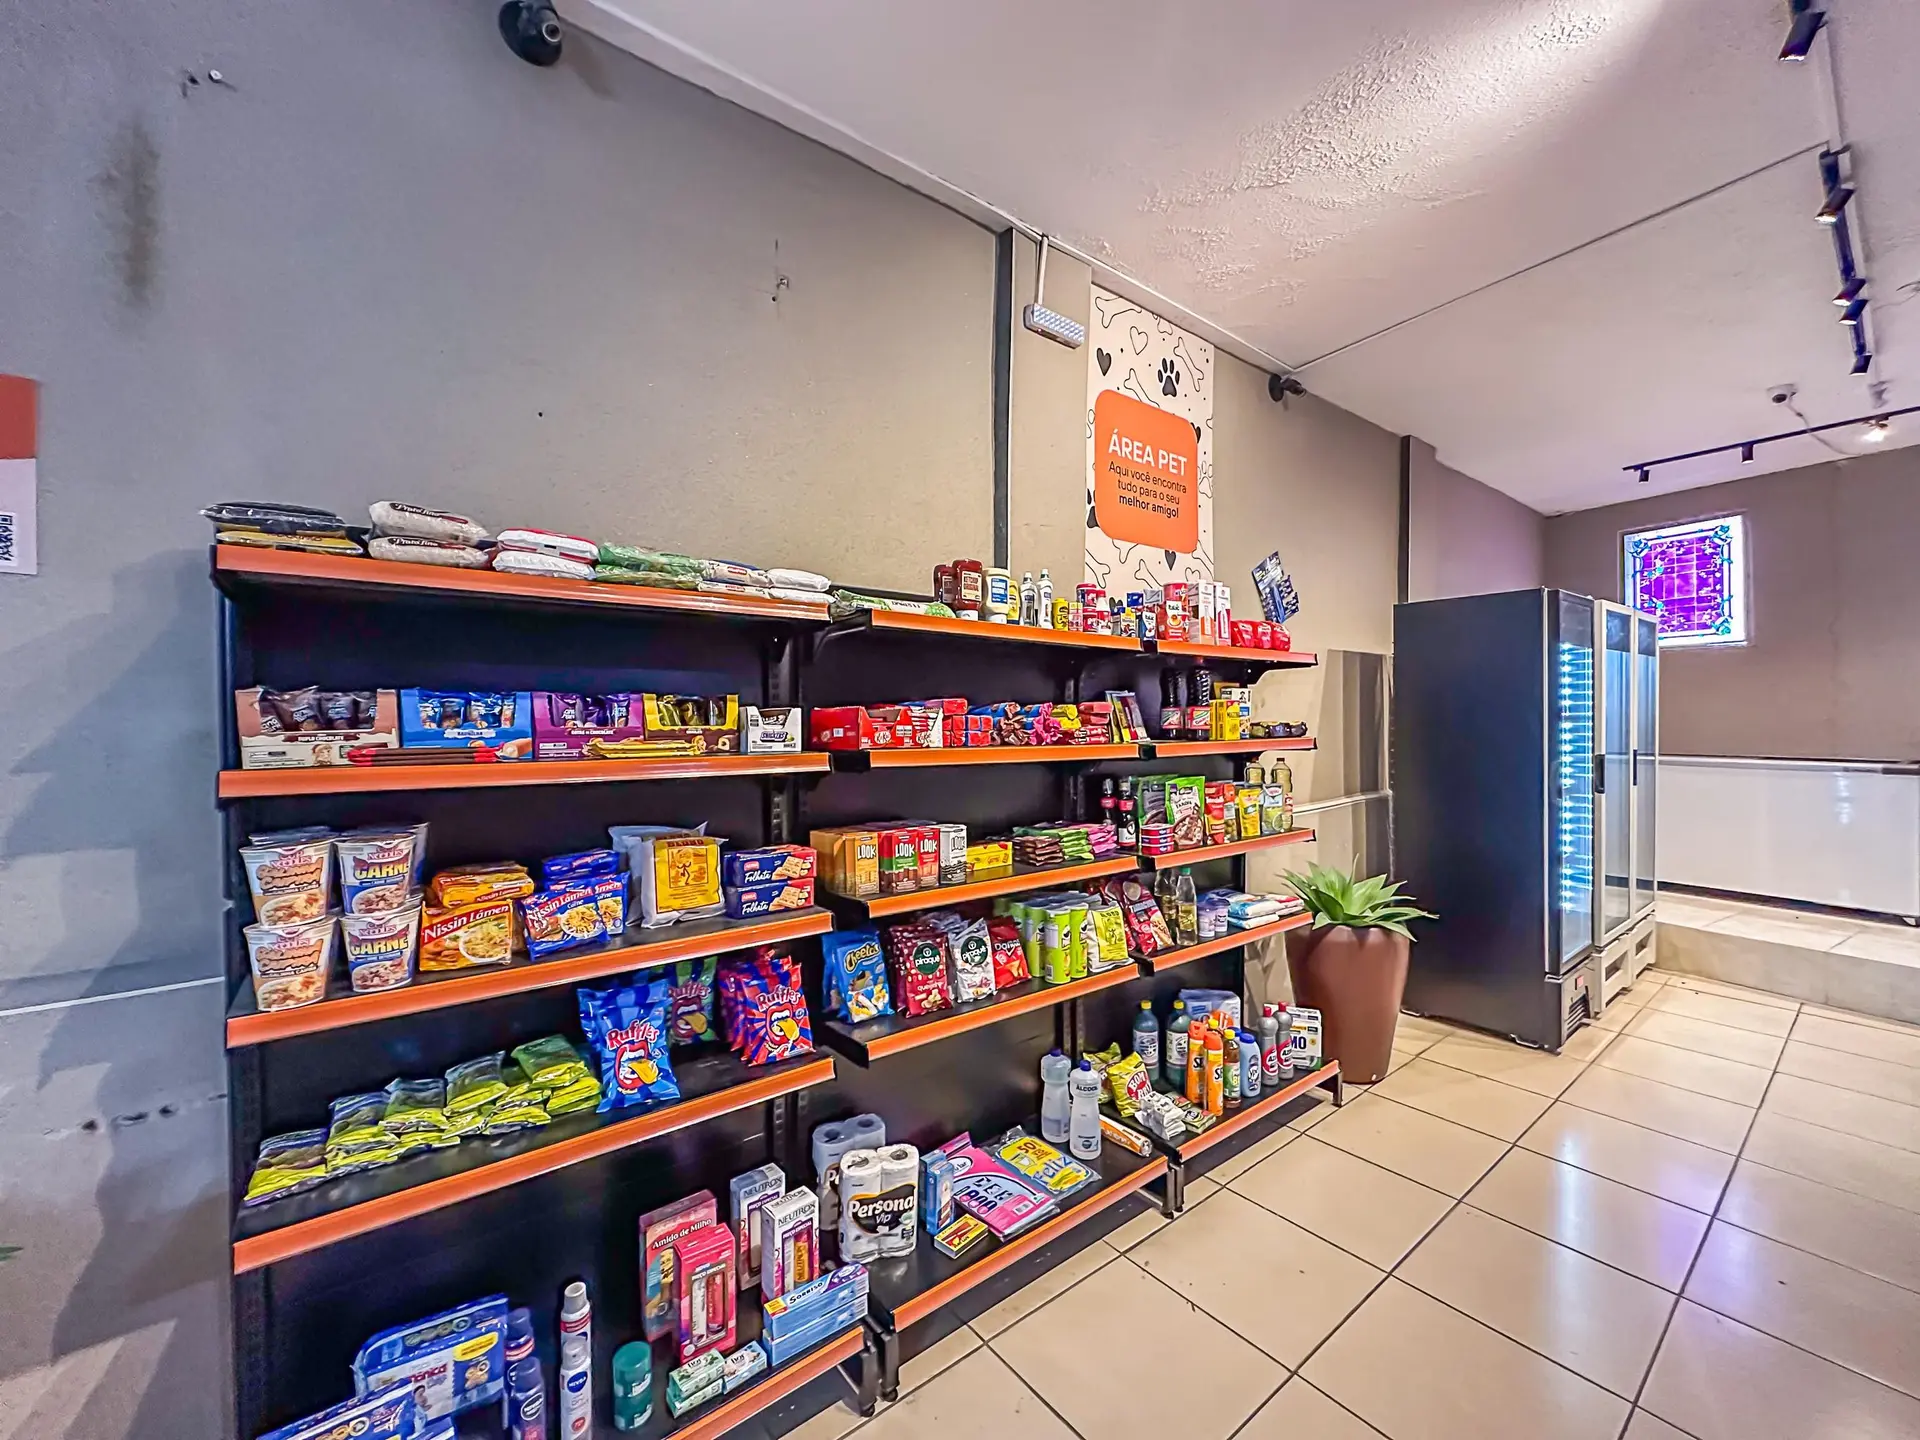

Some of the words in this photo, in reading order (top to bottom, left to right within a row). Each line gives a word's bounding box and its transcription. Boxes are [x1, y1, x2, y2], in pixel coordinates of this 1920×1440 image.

[1108, 428, 1155, 467] ÁREA
[1158, 448, 1188, 476] PET
[1108, 460, 1129, 478] Aqui
[1130, 470, 1151, 483] você
[1152, 475, 1187, 494] encontra
[1117, 479, 1138, 494] tudo
[1139, 485, 1158, 499] para
[1159, 491, 1165, 501] o
[1166, 494, 1180, 505] seu
[1118, 494, 1150, 511] melhor
[1151, 503, 1180, 519] amigo!
[857, 844, 876, 860] LOOK
[895, 842, 915, 858] LOOK
[920, 838, 938, 853] LOOK
[423, 913, 467, 943] Nissin
[468, 904, 510, 924] Lámen
[350, 936, 409, 956] CARNE
[668, 978, 711, 999] Ruffles
[756, 984, 800, 1012] Ruffles
[607, 1018, 660, 1050] Ruffles
[1130, 1070, 1146, 1088] BOM
[743, 1176, 783, 1197] NEUTROX
[778, 1202, 816, 1226] NEUTROX
[850, 1194, 915, 1218] Persona
[652, 1233, 679, 1250] Amido
[679, 1228, 690, 1237] de
[690, 1218, 713, 1234] Milho
[788, 1281, 824, 1305] SORRISO
